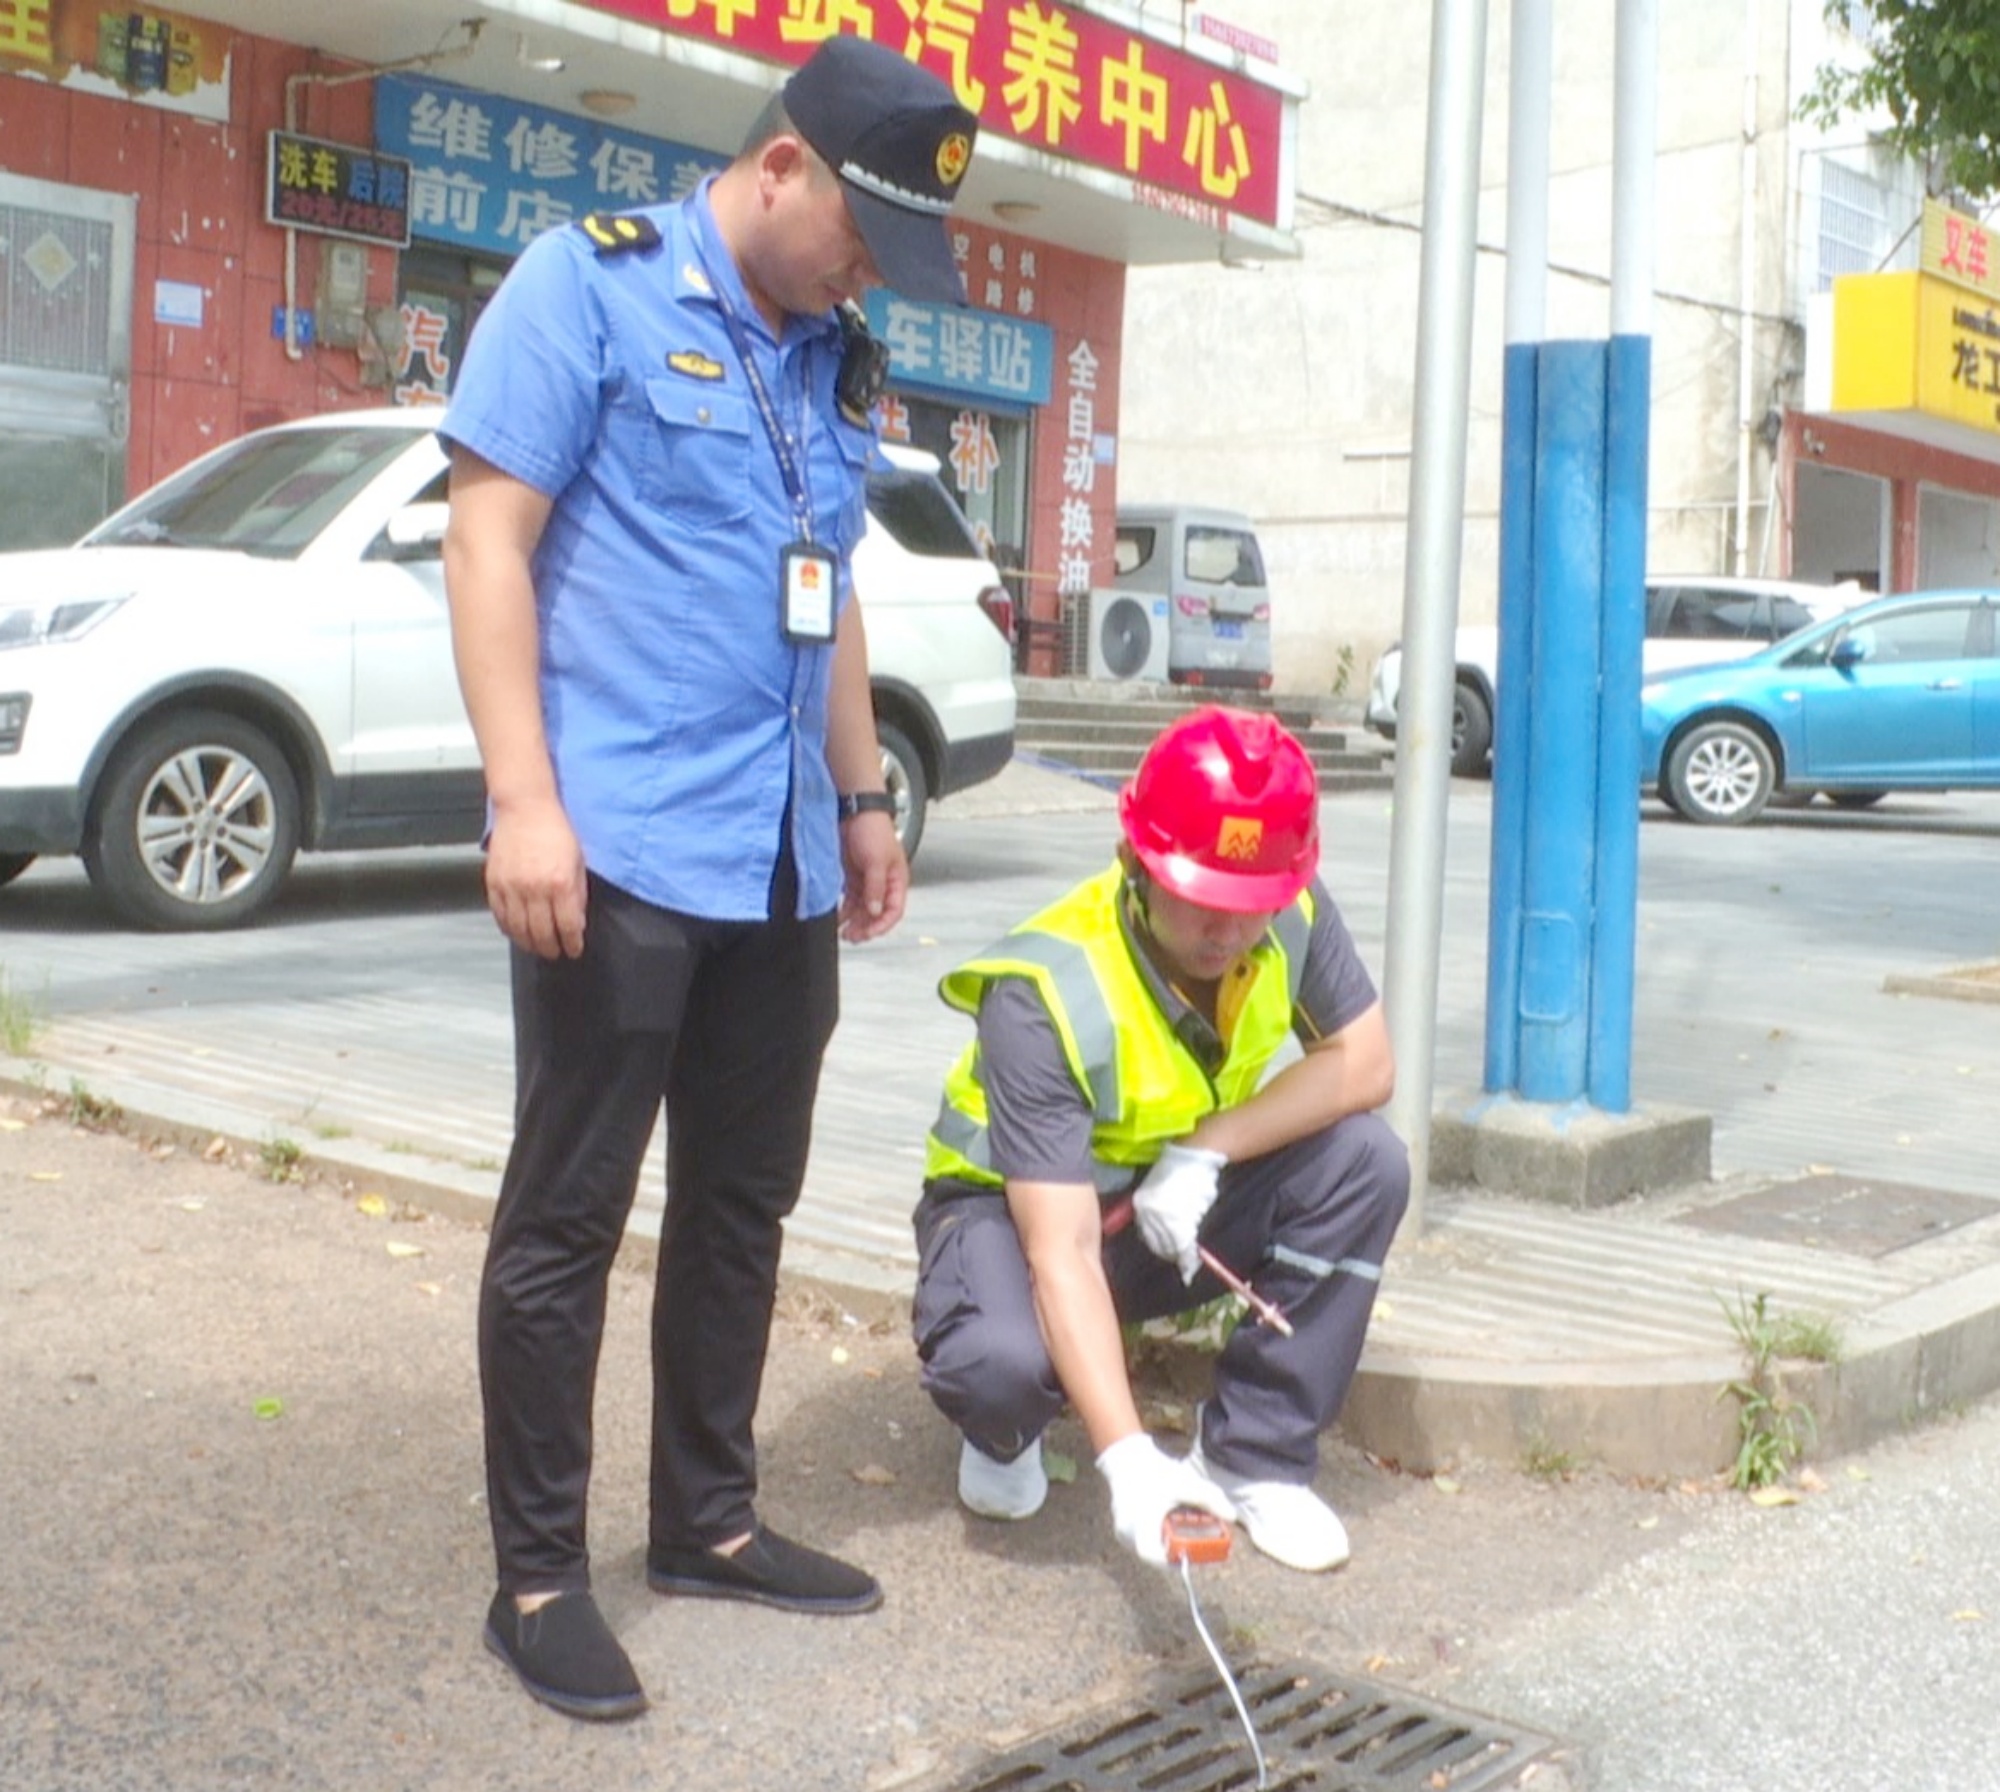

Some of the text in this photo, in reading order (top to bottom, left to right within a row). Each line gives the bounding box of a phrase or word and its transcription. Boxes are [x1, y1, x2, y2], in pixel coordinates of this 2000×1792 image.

[280, 142, 337, 194] 洗车
[886, 300, 1032, 392] 车驿站
[1057, 339, 1100, 593] 全自动换油
